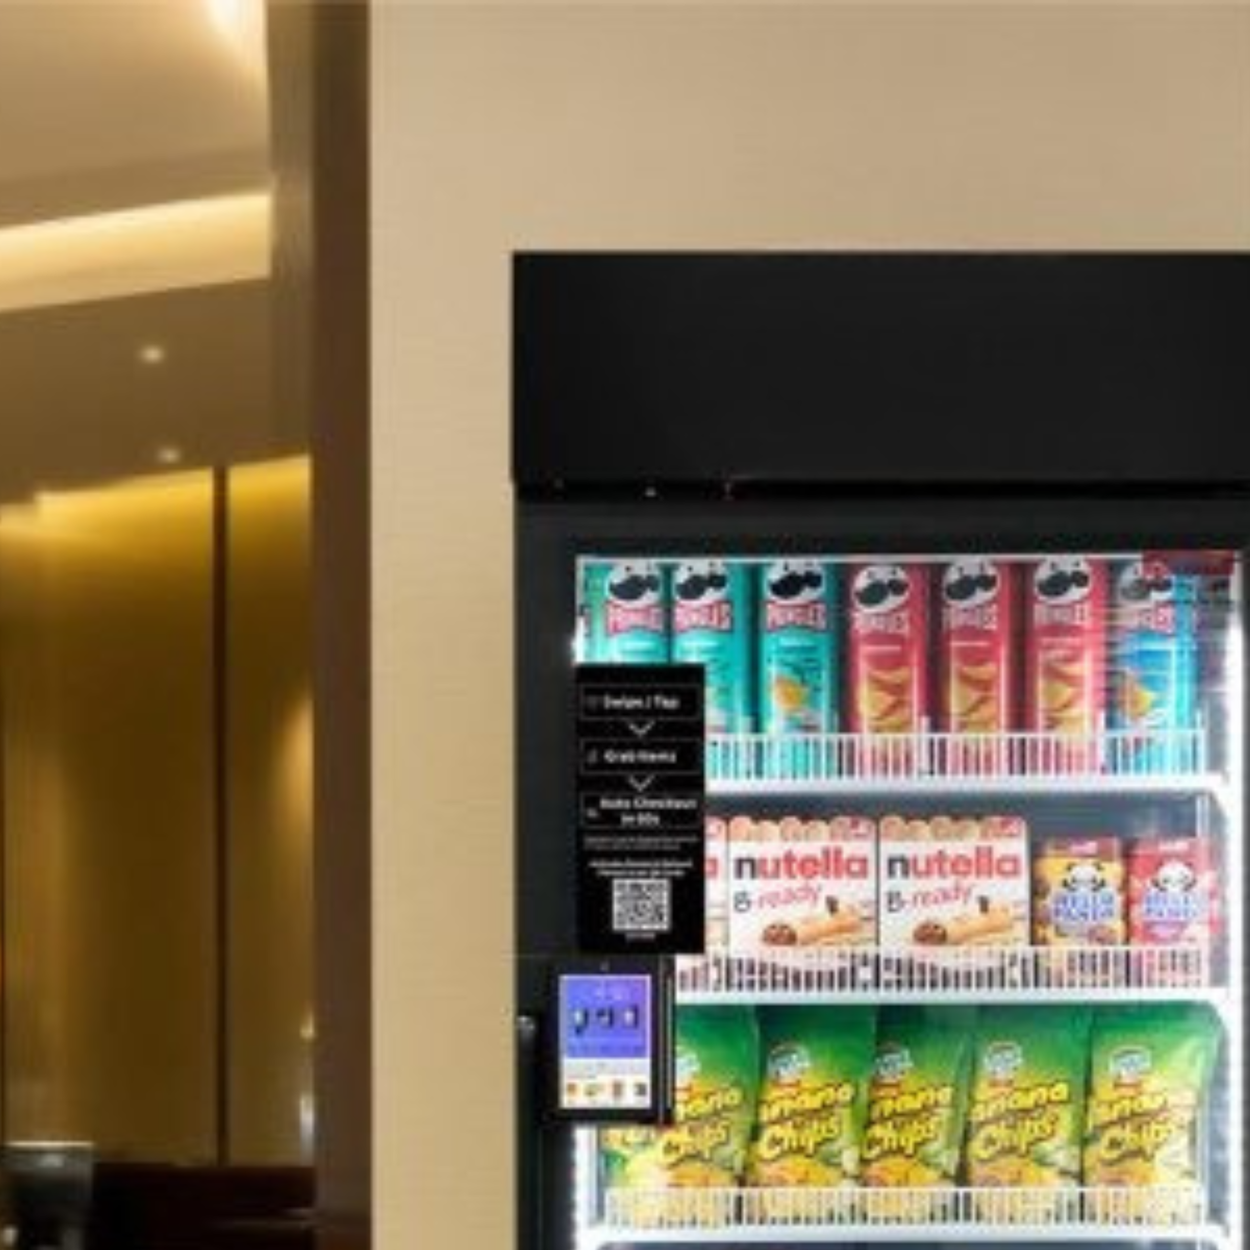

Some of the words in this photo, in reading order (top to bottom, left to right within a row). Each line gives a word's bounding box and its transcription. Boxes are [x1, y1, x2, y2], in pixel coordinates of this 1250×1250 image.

[733, 845, 869, 879] nutella
[887, 844, 1021, 879] nutella
[757, 1114, 840, 1160] Chips
[862, 1112, 939, 1163] Chips
[967, 1111, 1057, 1161] Chips
[1100, 1118, 1175, 1162] Chips
